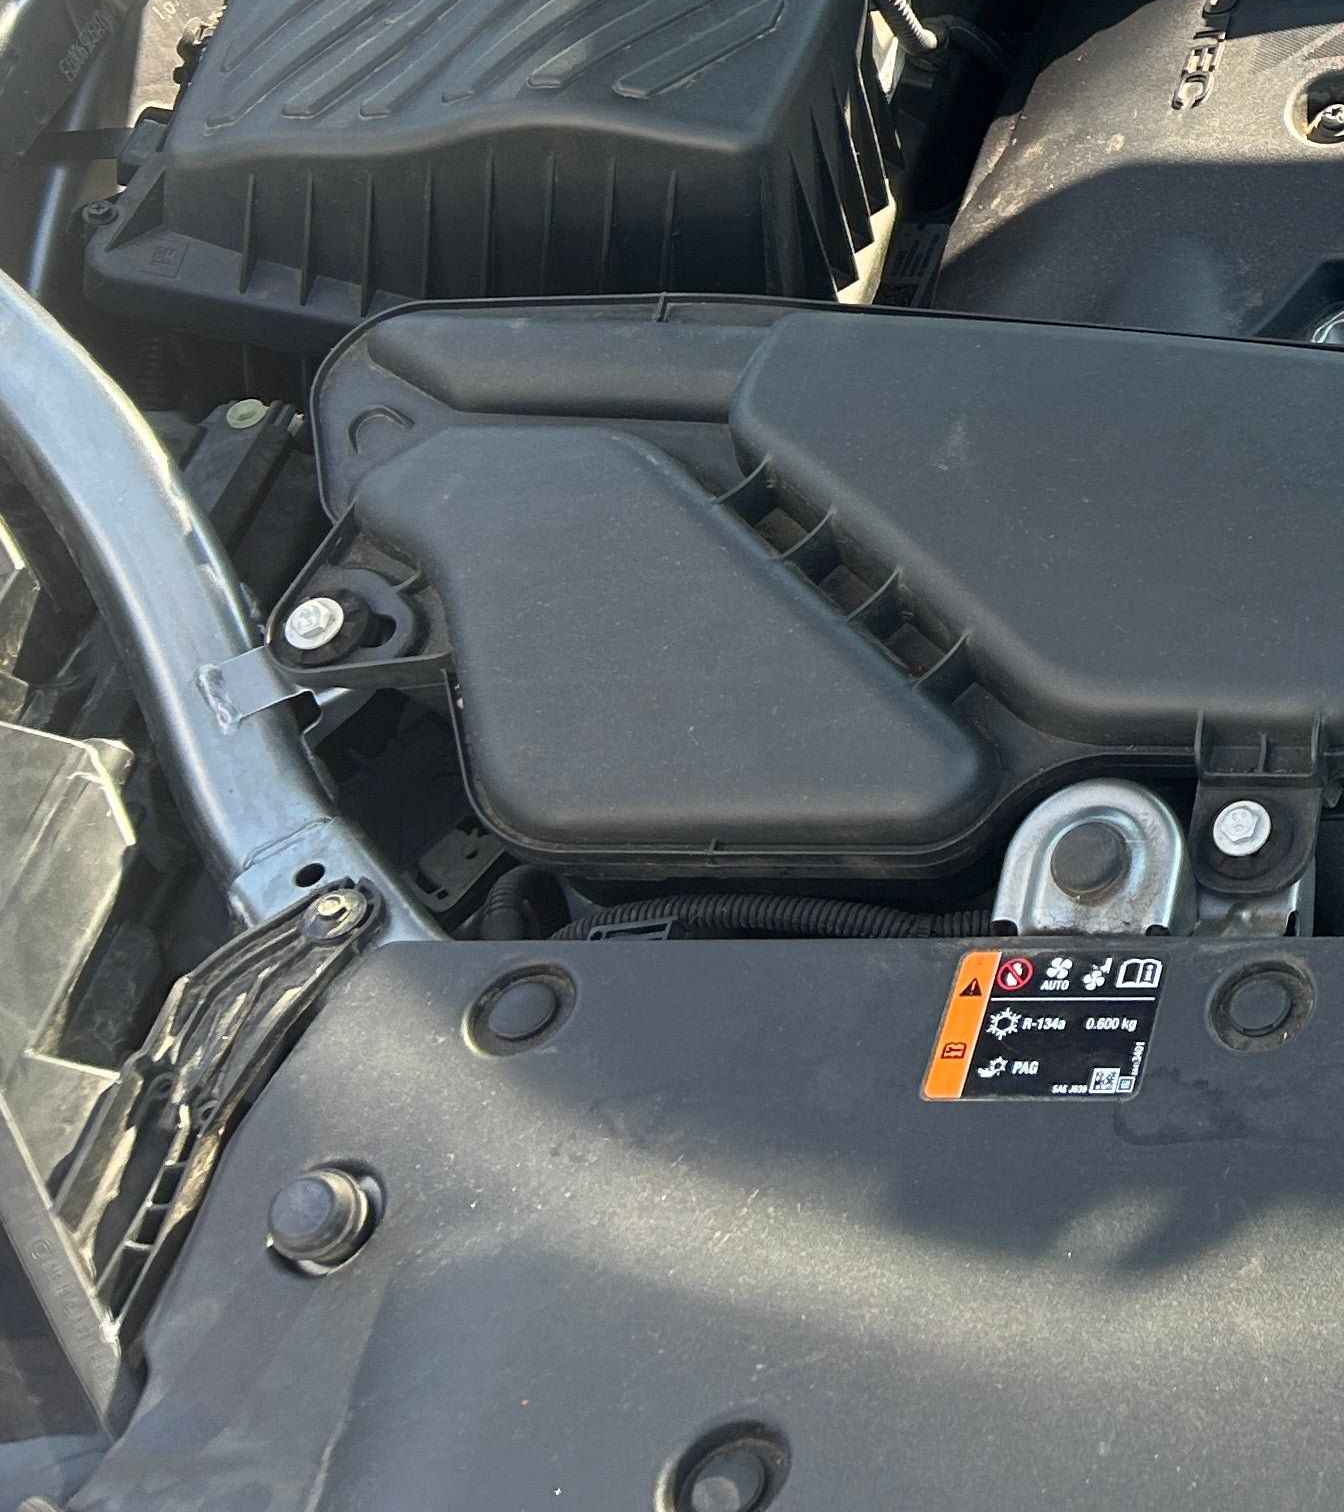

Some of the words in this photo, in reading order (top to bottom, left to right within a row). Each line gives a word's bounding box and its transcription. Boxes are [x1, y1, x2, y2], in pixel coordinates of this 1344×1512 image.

[1040, 979, 1070, 991] AUTO
[1022, 1017, 1066, 1030] R-134a
[1085, 1017, 1120, 1030] 0.600
[1121, 1017, 1138, 1033] kg
[1011, 1060, 1040, 1075] PAG
